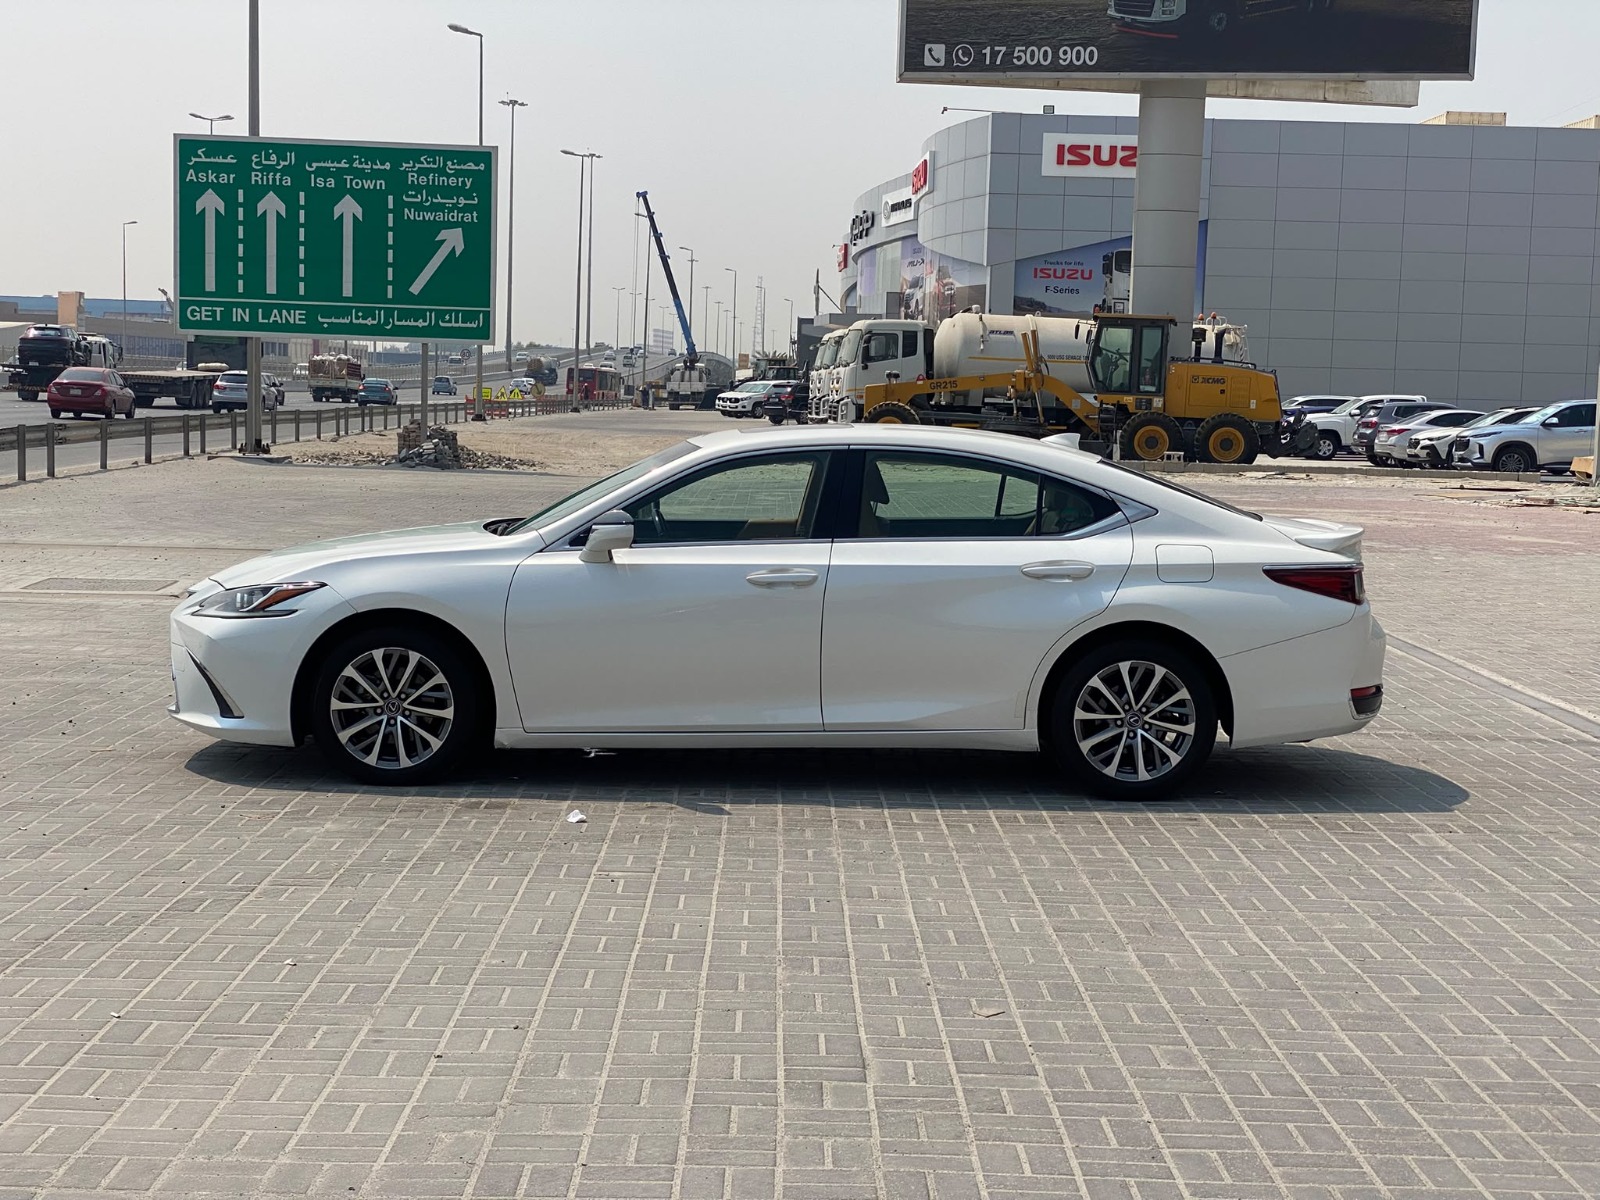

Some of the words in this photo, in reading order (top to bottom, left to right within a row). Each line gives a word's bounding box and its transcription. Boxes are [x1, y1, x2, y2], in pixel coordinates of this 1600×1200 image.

[981, 46, 1006, 65] 17
[1012, 46, 1052, 65] 500
[1058, 46, 1098, 66] 900
[187, 148, 237, 165] عسكر
[251, 150, 295, 169] الرفاع
[352, 155, 391, 172] مدينة
[399, 155, 443, 171] التكرير
[1056, 144, 1138, 167] ISUZ
[305, 159, 350, 172] عيسى
[446, 160, 485, 173] مصنع
[186, 169, 236, 184] Askar
[251, 172, 291, 186] Riffa
[310, 174, 335, 188] Isa
[344, 175, 385, 190] Town
[408, 173, 472, 189] Refinery
[403, 189, 478, 207] نويدرات
[404, 208, 478, 223] Nuwaidrat
[1033, 267, 1093, 280] ISUZU
[1045, 285, 1080, 294] F-Series
[186, 305, 224, 321] GET
[232, 307, 249, 322] IN
[258, 308, 306, 324] LANE
[438, 311, 483, 328] اسلك
[929, 380, 958, 390] GR215
